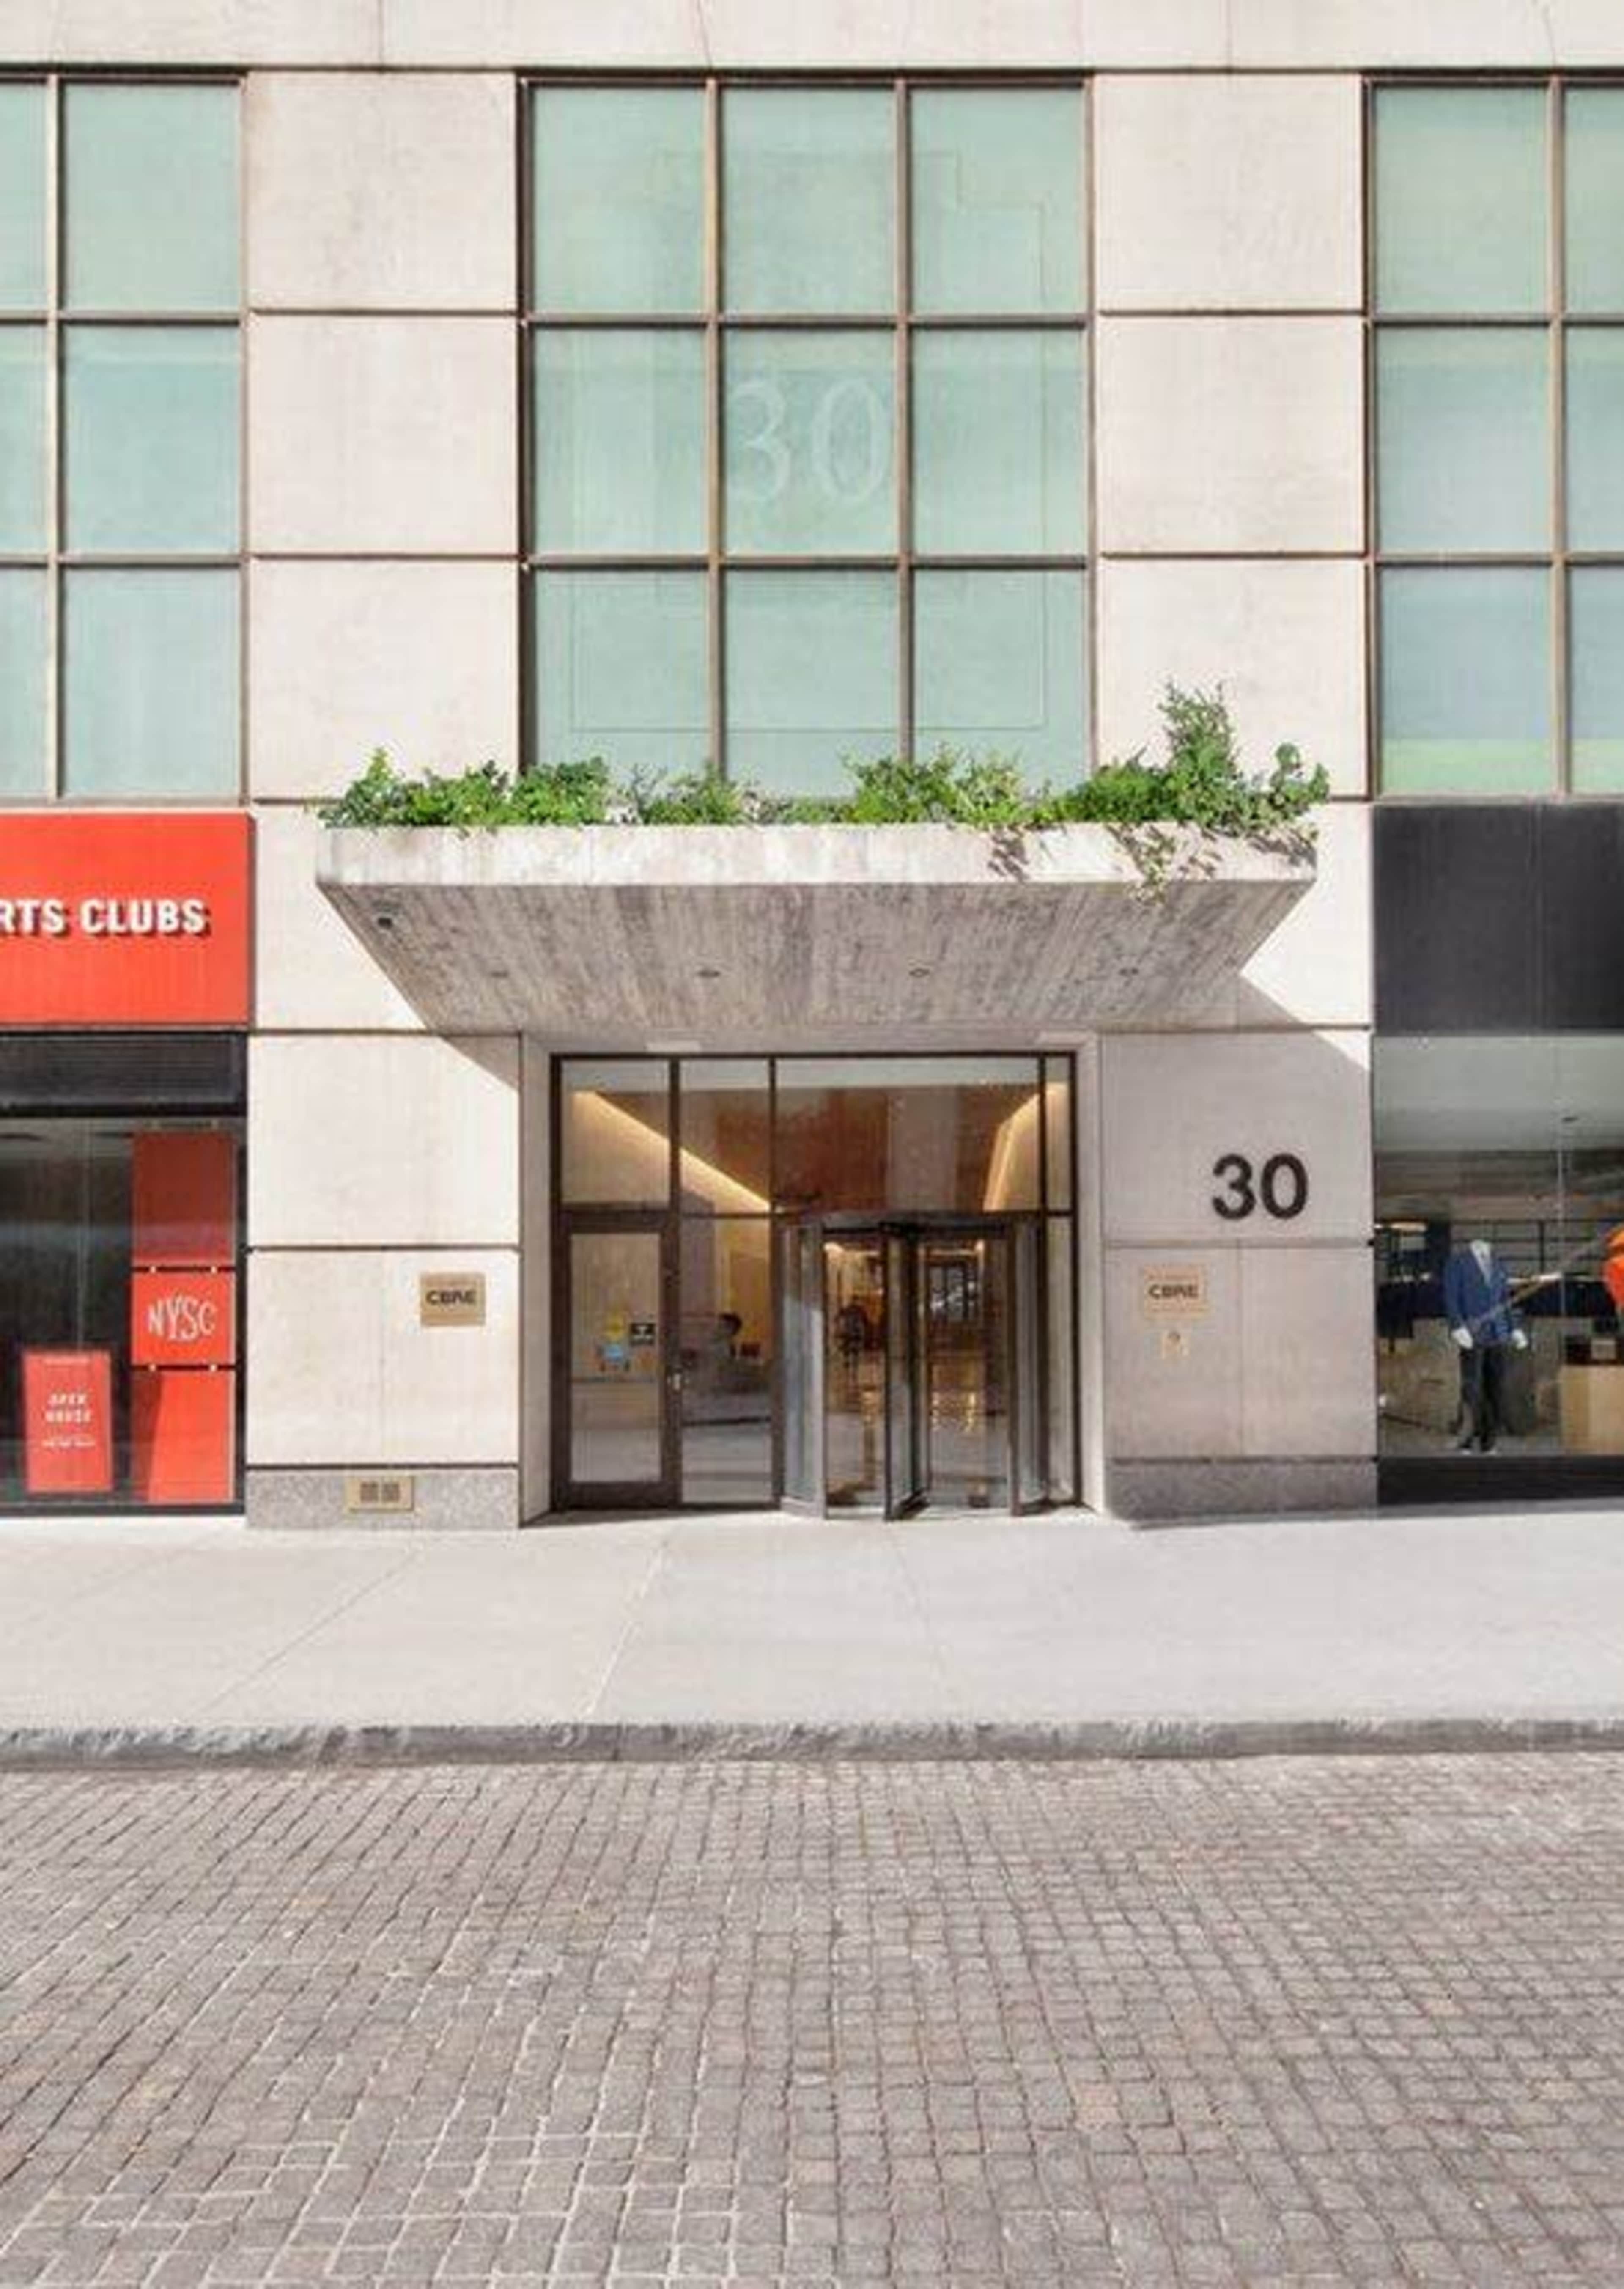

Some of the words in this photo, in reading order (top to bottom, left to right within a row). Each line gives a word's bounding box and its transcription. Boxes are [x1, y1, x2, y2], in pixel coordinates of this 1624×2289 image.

[727, 380, 888, 505] 30
[80, 898, 208, 934] CLUBS
[1212, 1153, 1309, 1220] 30
[148, 1294, 217, 1341] NYSC
